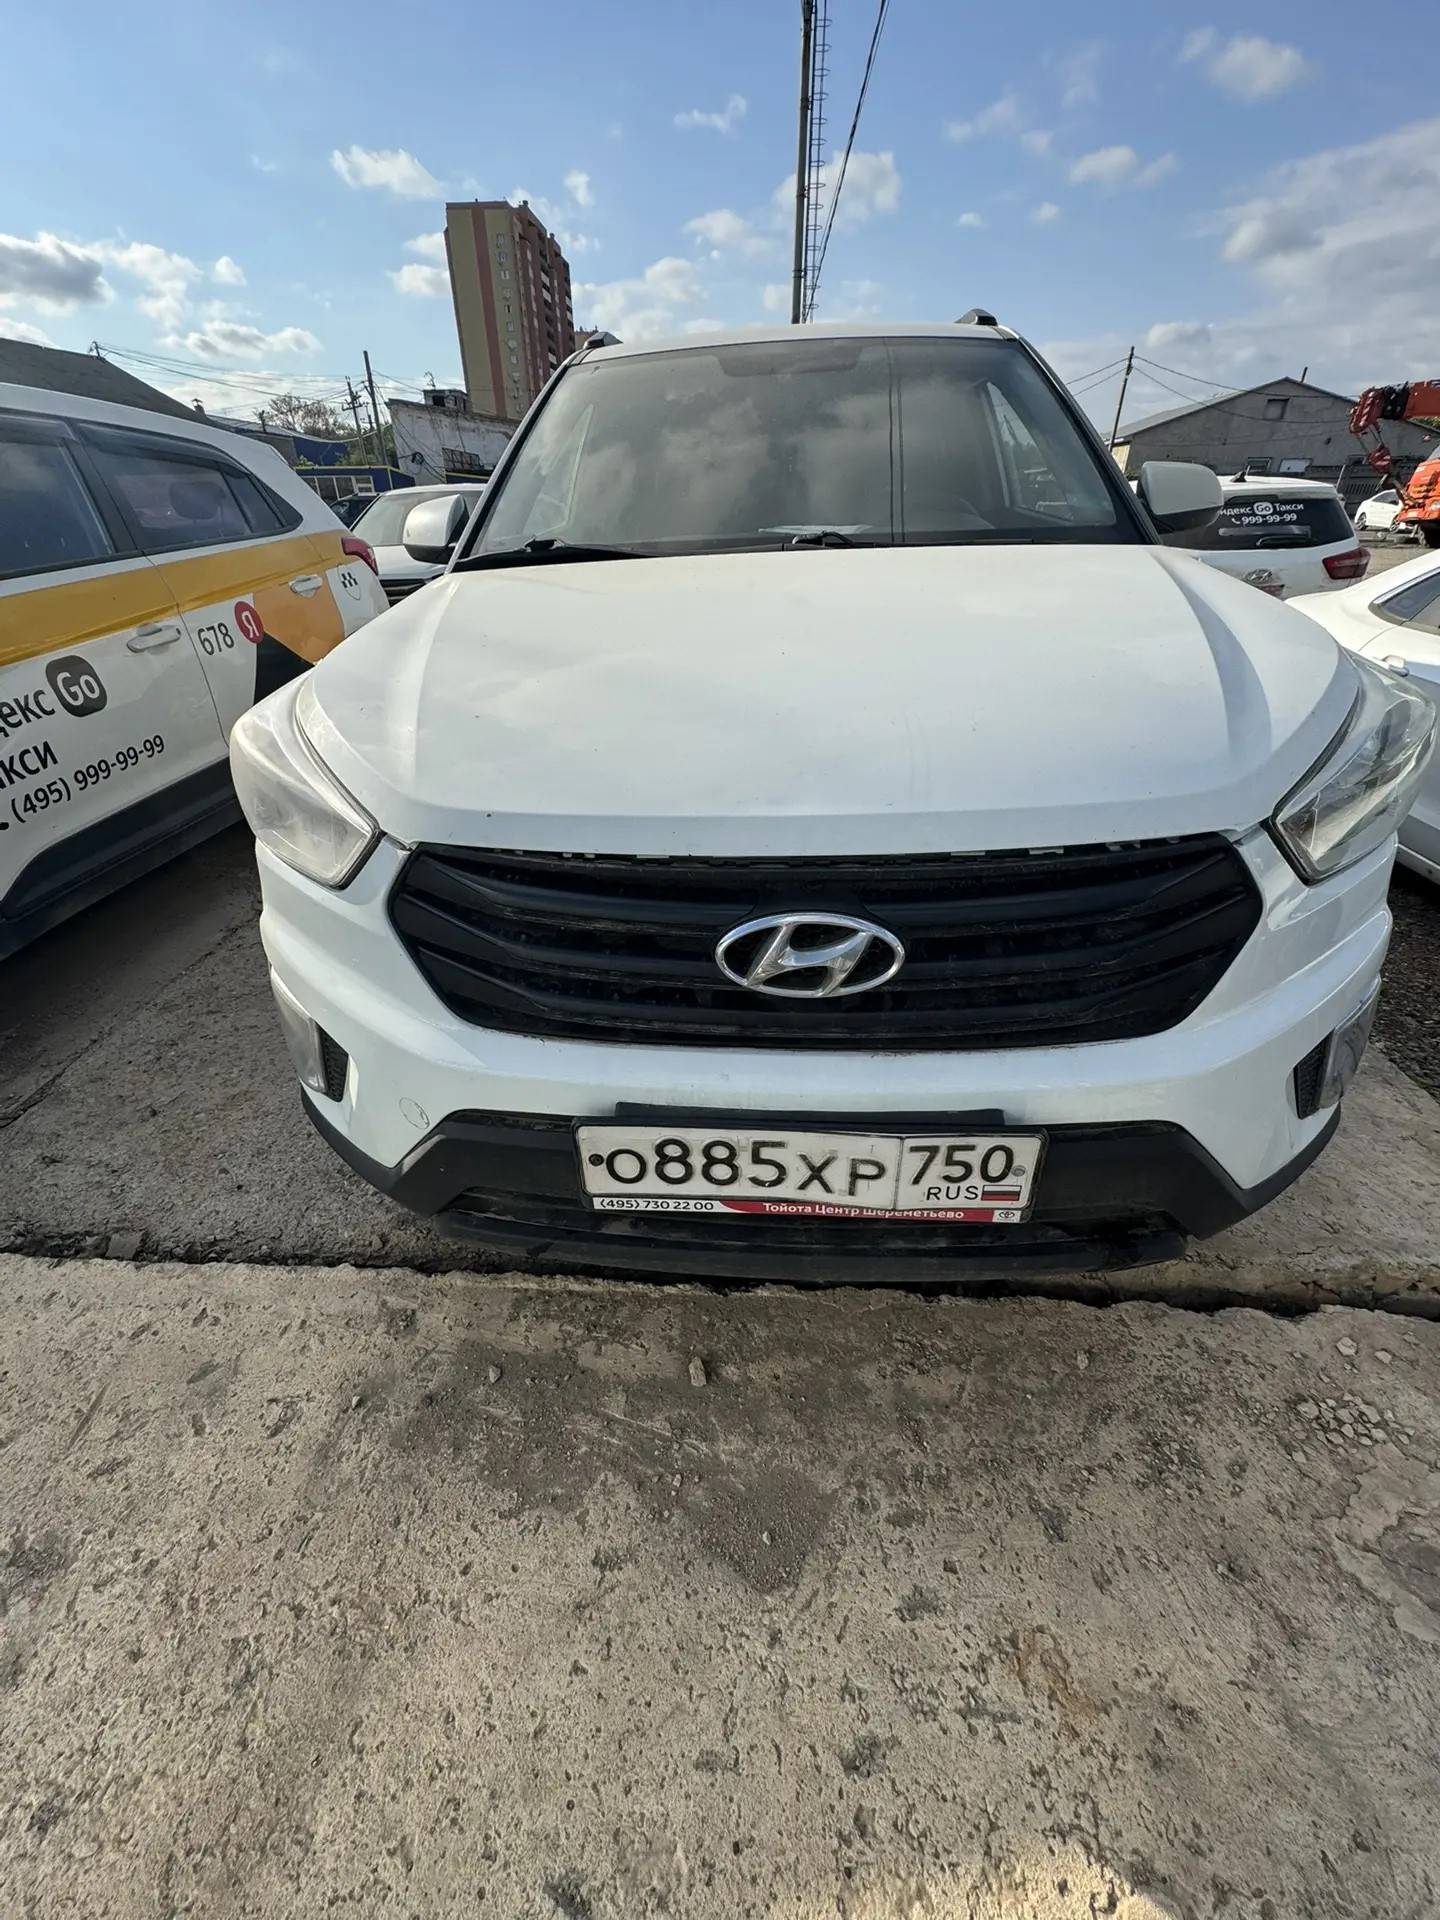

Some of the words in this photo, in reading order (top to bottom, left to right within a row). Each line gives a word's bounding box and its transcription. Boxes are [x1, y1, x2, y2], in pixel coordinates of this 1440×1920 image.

[1216, 505, 1253, 516] ндекс
[1255, 503, 1272, 513] Go
[1274, 503, 1304, 511] Такси
[1241, 513, 1297, 525] 999-99-99
[197, 622, 235, 656] 678
[241, 610, 260, 639] Я
[0, 689, 56, 738] екс
[56, 671, 100, 706] Go
[0, 740, 58, 790] кси
[11, 777, 72, 824] (495)
[73, 734, 165, 792] 999-99-99
[909, 1144, 1014, 1185] 750
[600, 1199, 640, 1209] (495)
[643, 1200, 670, 1210] 730
[672, 1201, 691, 1210] 22
[693, 1201, 714, 1211] 00
[926, 1185, 979, 1201] RUS
[763, 1202, 812, 1214] Тойота
[815, 1204, 860, 1217] Центр
